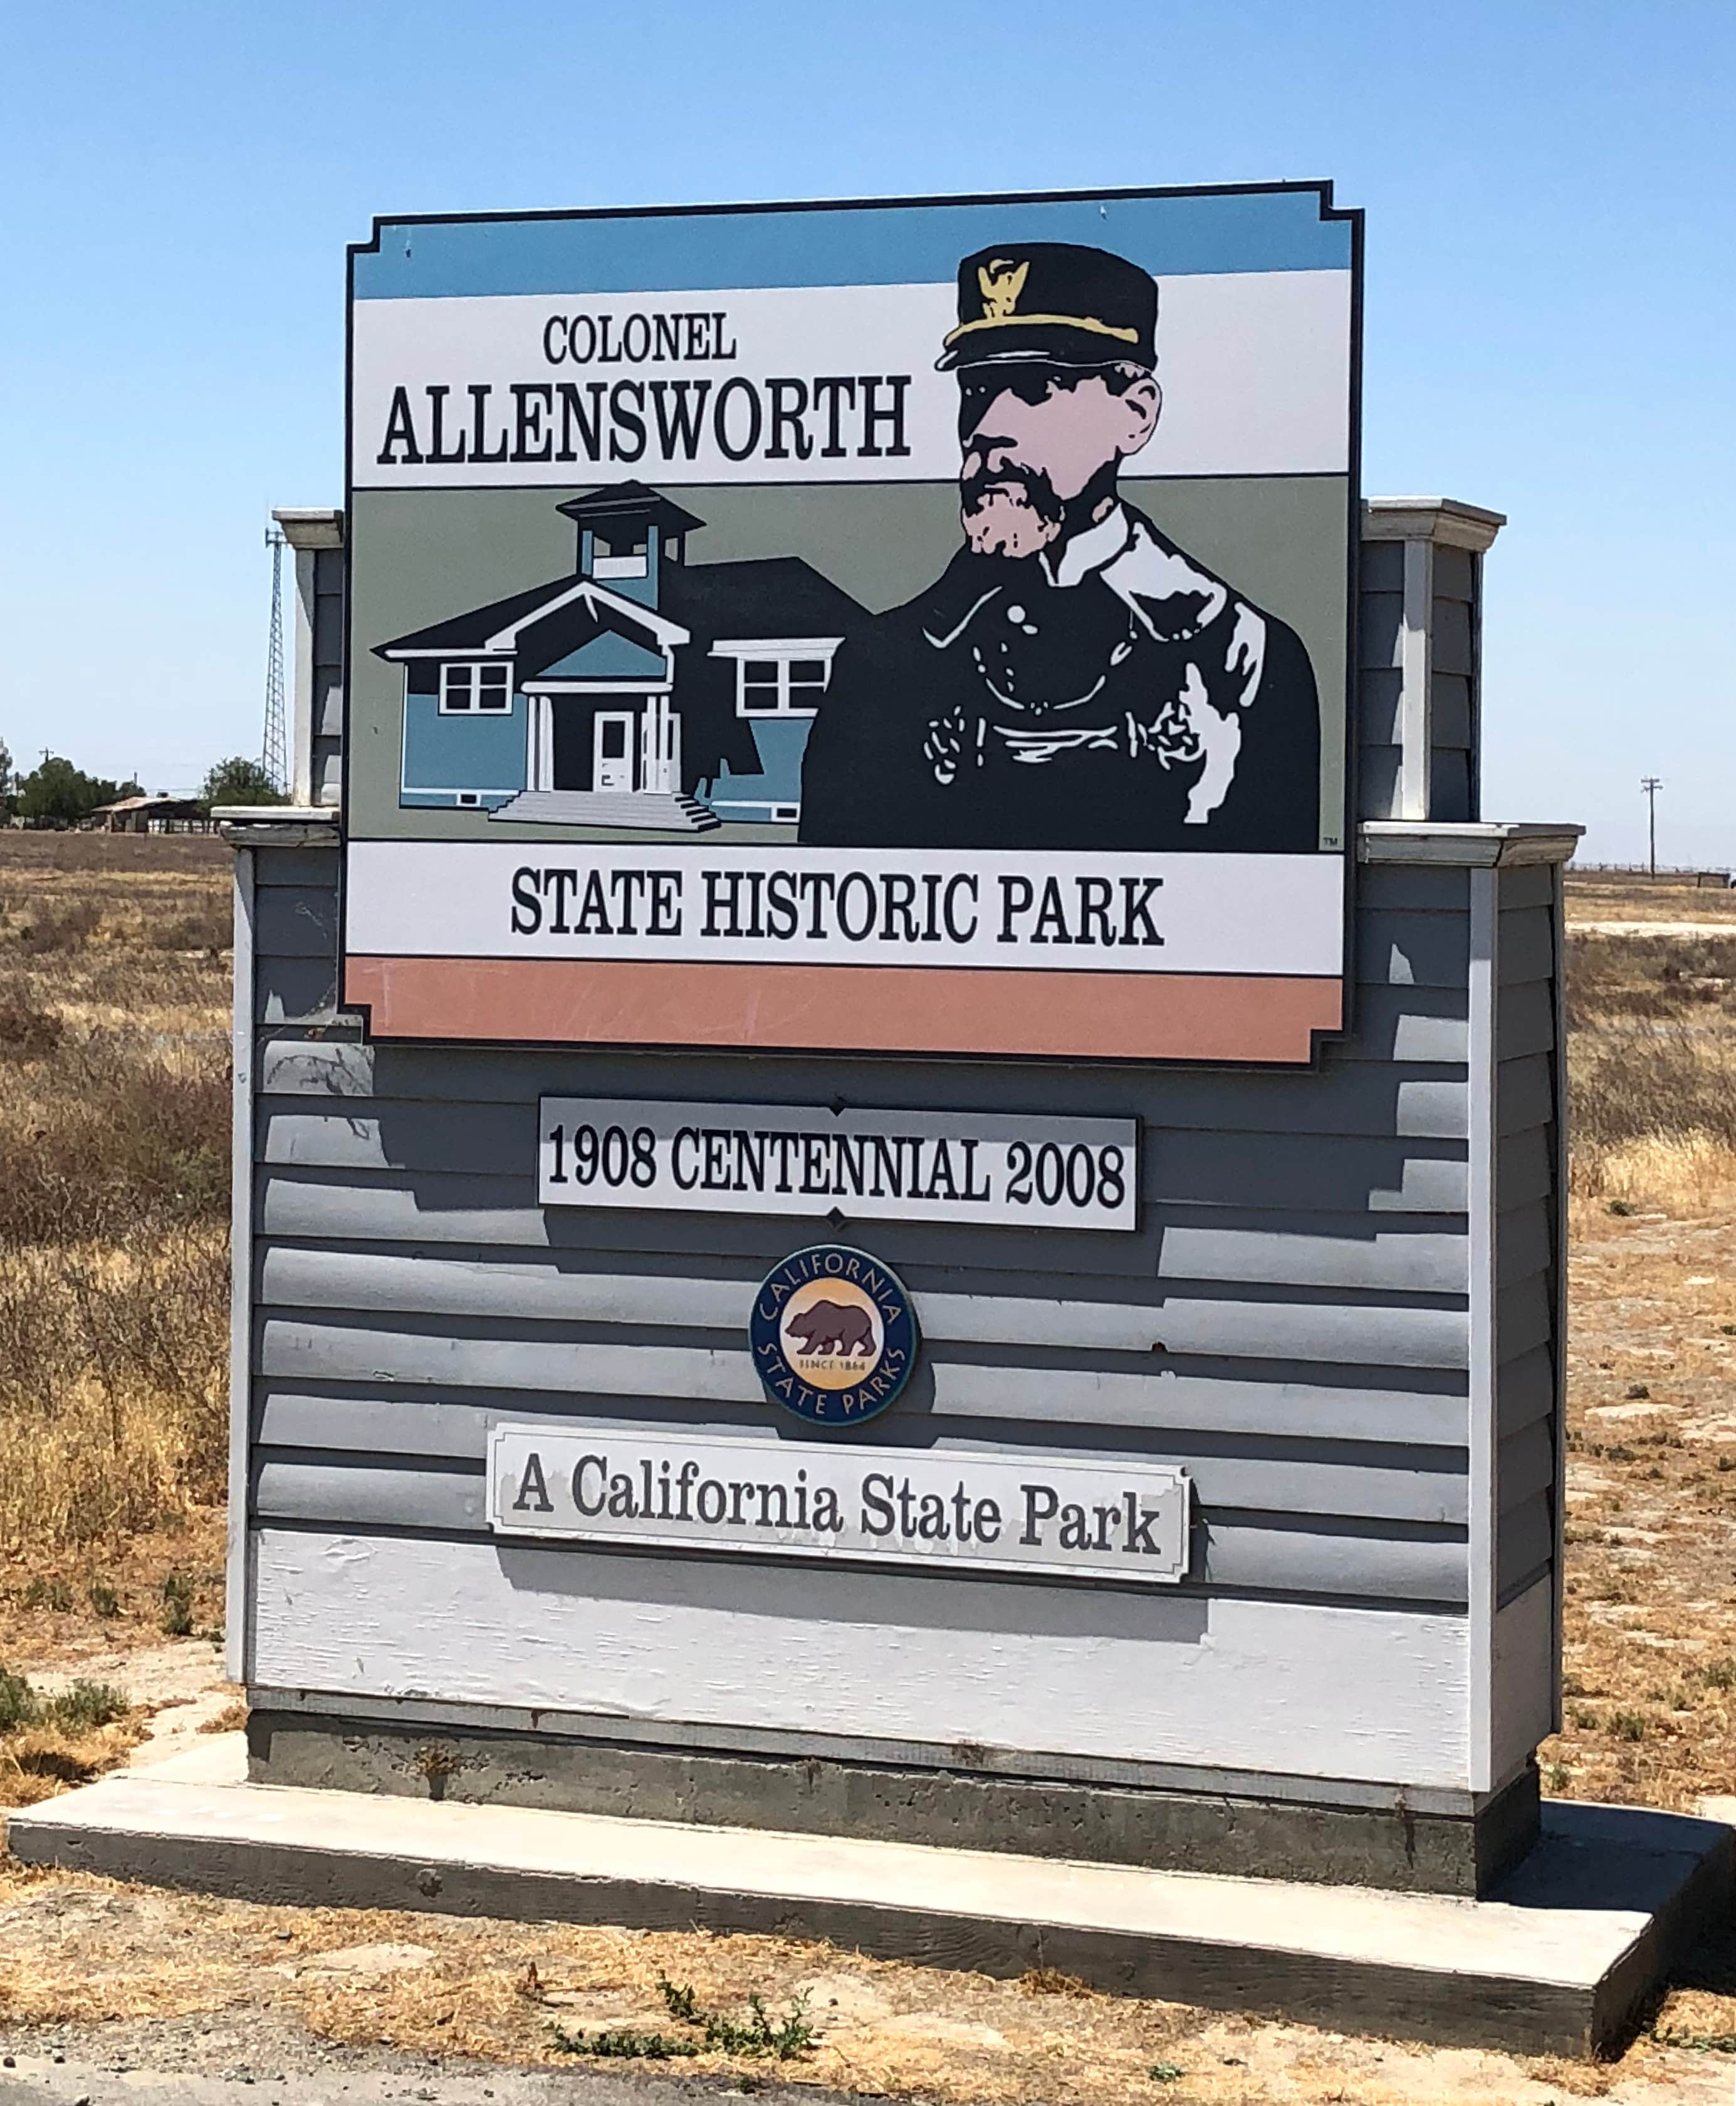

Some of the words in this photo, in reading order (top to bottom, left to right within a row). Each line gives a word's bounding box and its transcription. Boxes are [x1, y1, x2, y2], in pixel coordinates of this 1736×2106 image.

[543, 312, 737, 364] COLONEL
[376, 375, 912, 465] ALLENSWORTH
[1323, 837, 1338, 846] TM
[511, 867, 683, 936] STATE
[699, 870, 979, 944] HISTORIC
[996, 875, 1164, 947] PARK
[548, 1123, 657, 1189] 1908
[671, 1127, 991, 1202] CENTENNIAL
[1006, 1141, 1126, 1209] 2008
[760, 1253, 902, 1325] CALIFORNIA
[758, 1343, 827, 1414] STATE
[843, 1348, 905, 1414] PARKS
[800, 1359, 835, 1370] SINCE
[840, 1360, 866, 1371] 1864
[513, 1452, 554, 1513] A
[570, 1453, 844, 1532] California
[861, 1473, 1002, 1543] State
[1018, 1484, 1161, 1555] Park
